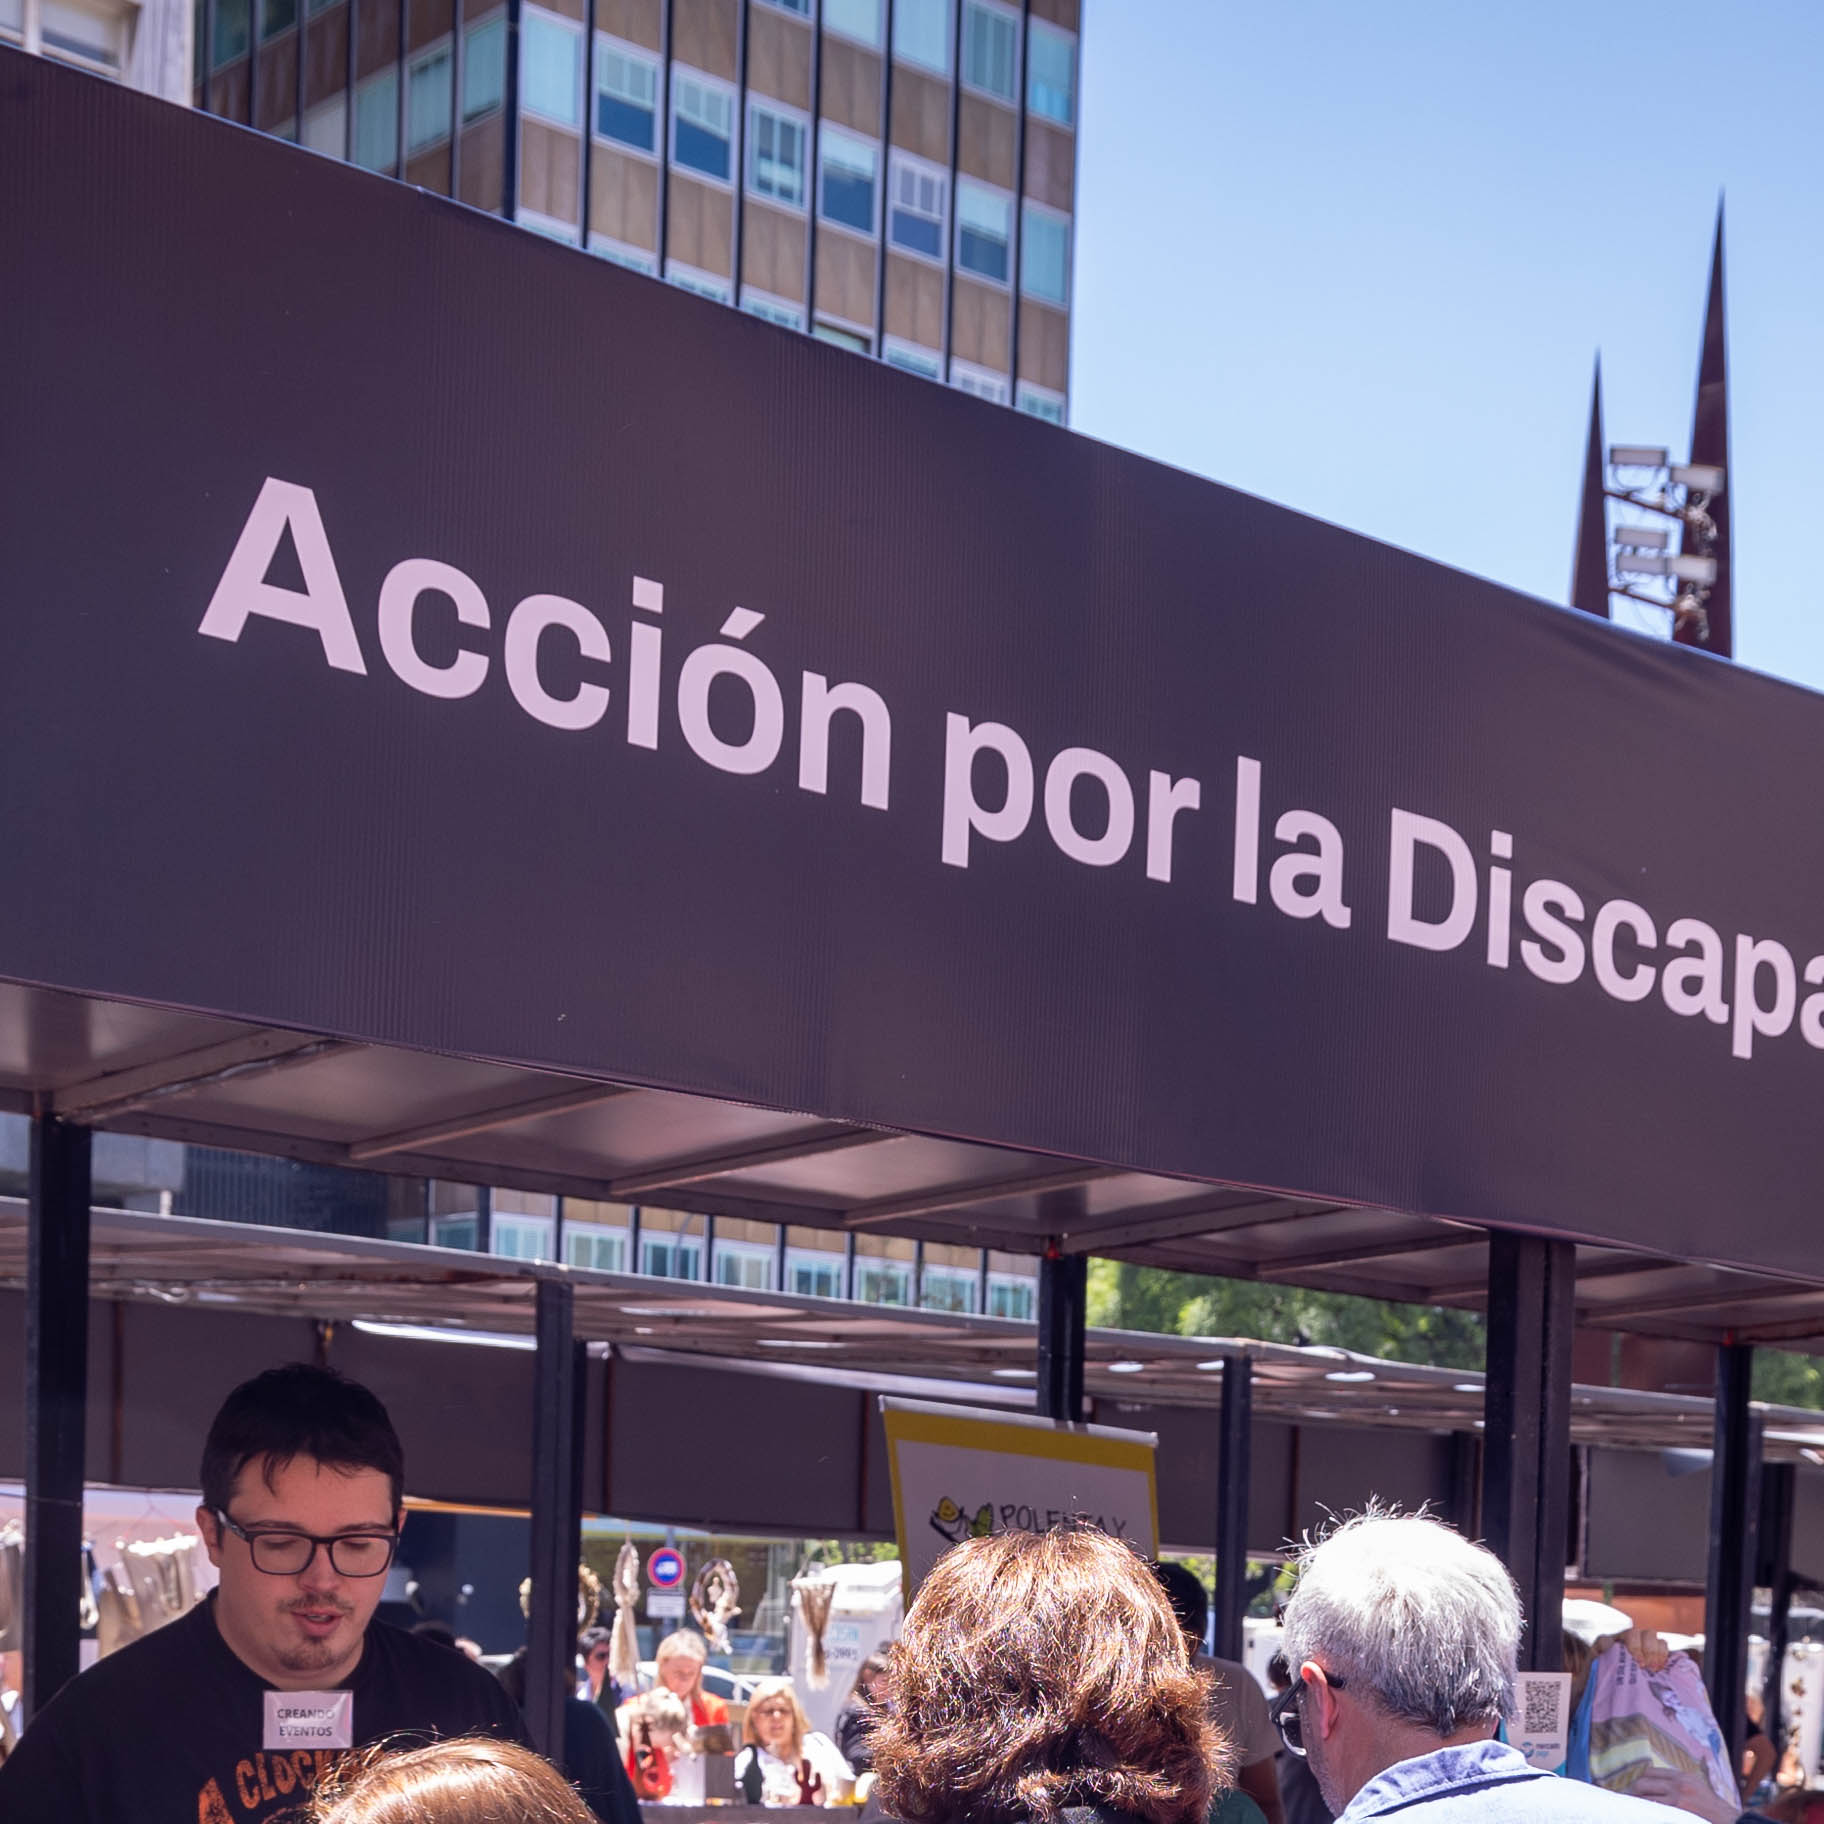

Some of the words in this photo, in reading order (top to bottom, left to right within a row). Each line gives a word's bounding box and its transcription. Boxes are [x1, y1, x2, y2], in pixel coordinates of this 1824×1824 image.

[198, 476, 892, 811] Acción
[941, 711, 1201, 883] por
[1233, 755, 1351, 929] la
[277, 1708, 336, 1720] CREANDO
[279, 1726, 333, 1737] EVENTOS
